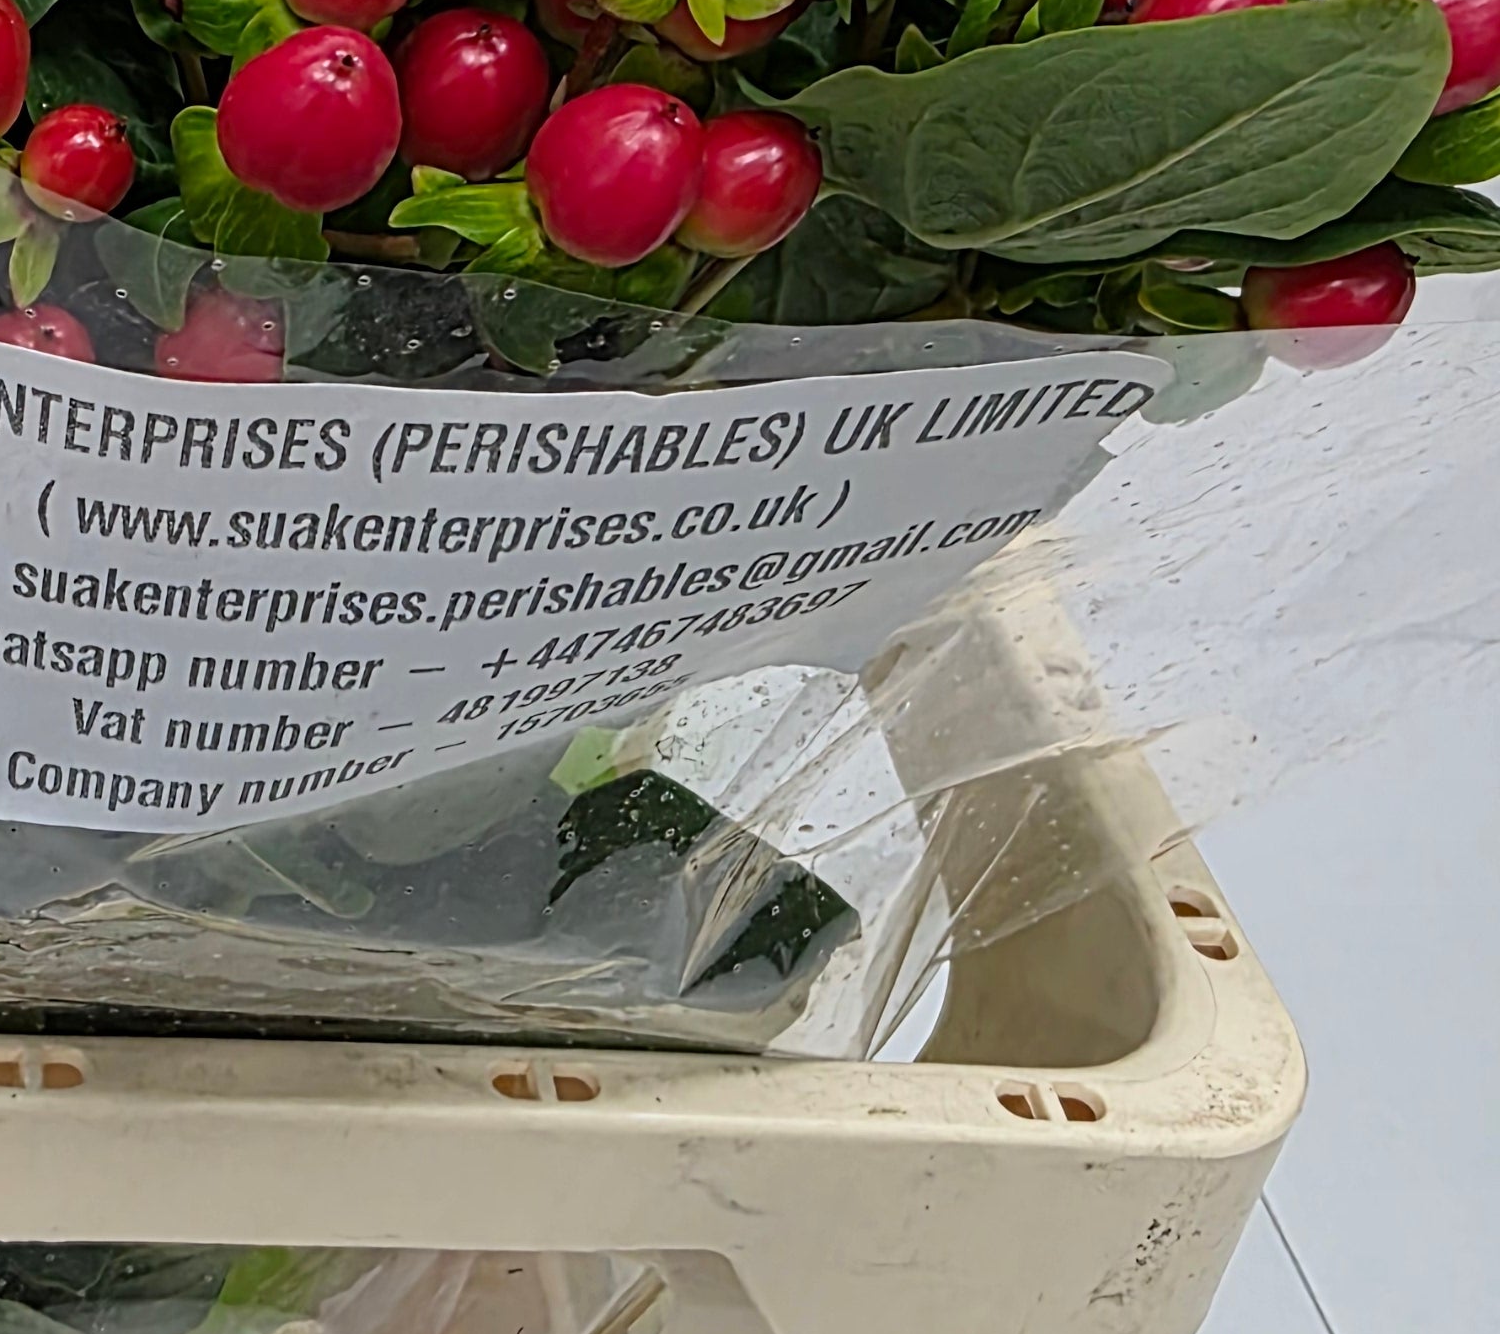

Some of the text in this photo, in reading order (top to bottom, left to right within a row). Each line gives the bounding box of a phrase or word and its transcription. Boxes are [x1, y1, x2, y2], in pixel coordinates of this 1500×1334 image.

[372, 411, 806, 483] (PERISHABLES)
[823, 402, 914, 455] UK
[915, 379, 1155, 444] LIMITED
[76, 484, 819, 563] www.suakenterprises.co.uk
[12, 508, 1043, 633] suakenterprises.perishables@gmail.com
[72, 698, 145, 745] Vat
[164, 715, 354, 753] number
[437, 653, 683, 724] 481997138
[188, 651, 385, 691] number
[7, 751, 224, 817] Company
[237, 747, 415, 806] number
